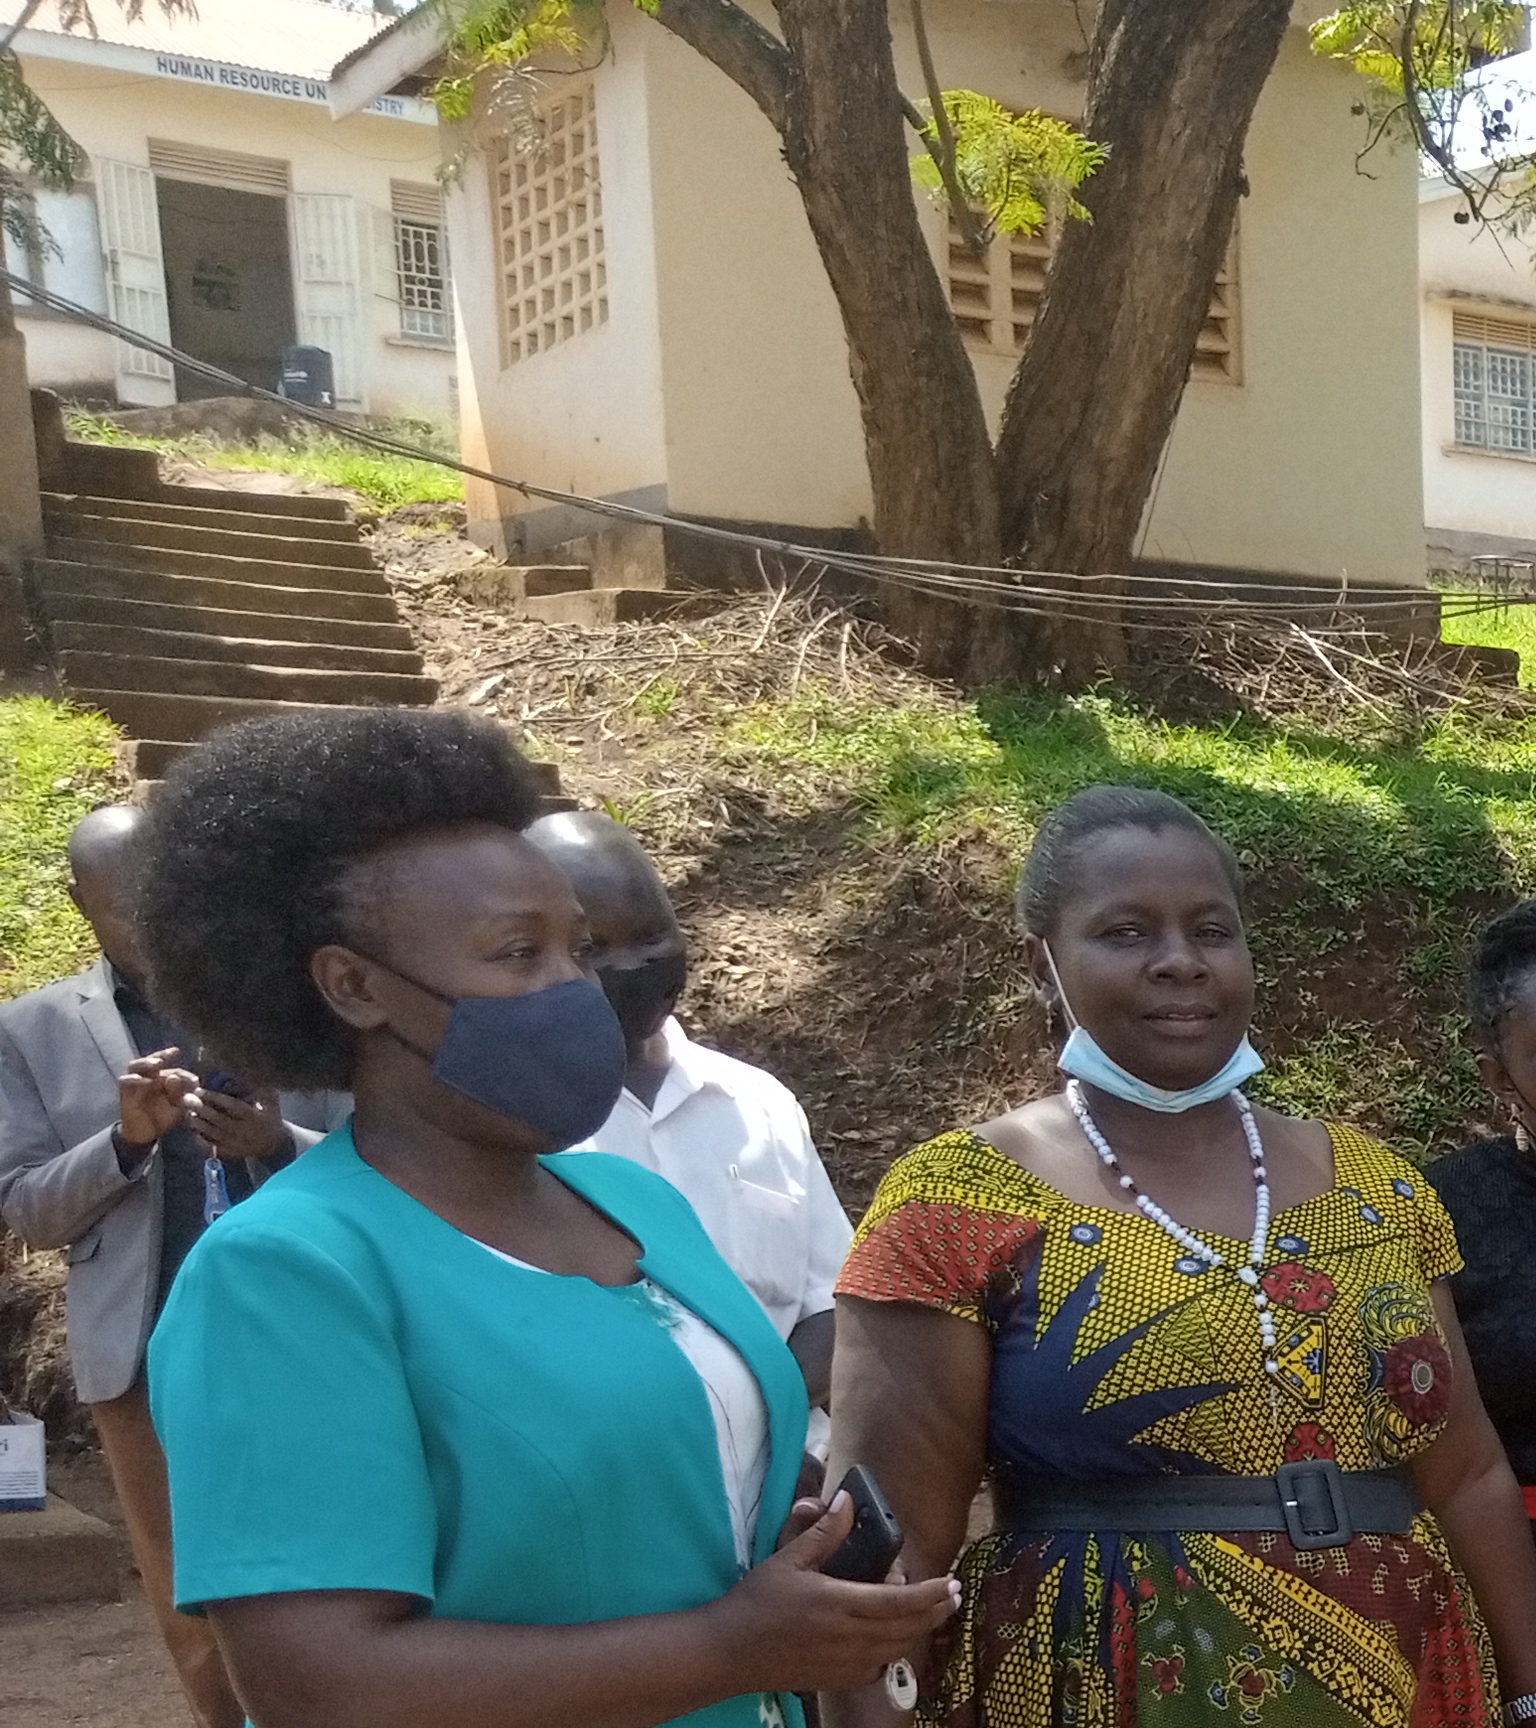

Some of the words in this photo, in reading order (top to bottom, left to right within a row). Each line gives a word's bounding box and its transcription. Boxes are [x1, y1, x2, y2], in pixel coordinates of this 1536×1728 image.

[156, 56, 214, 82] HUMAN
[219, 67, 302, 97] RESOURCE
[305, 82, 327, 100] UN
